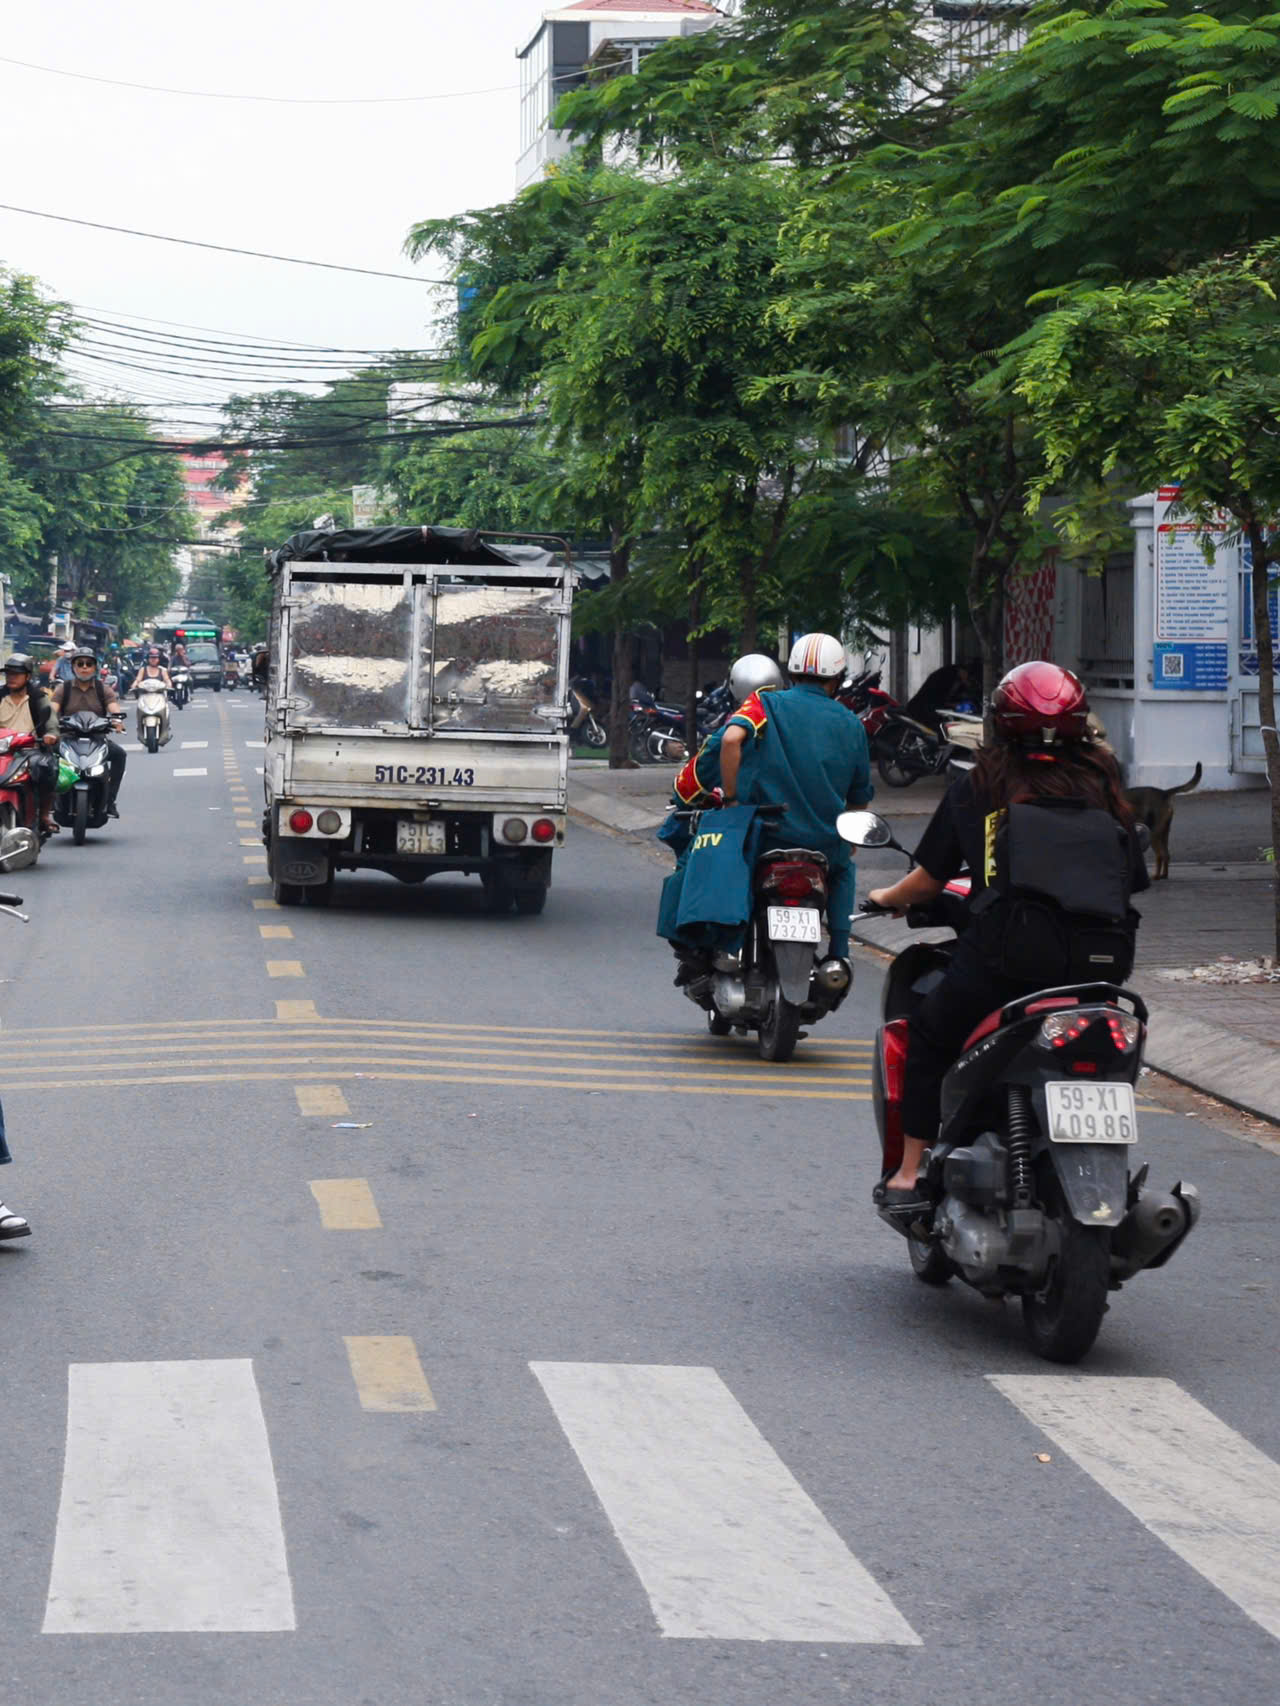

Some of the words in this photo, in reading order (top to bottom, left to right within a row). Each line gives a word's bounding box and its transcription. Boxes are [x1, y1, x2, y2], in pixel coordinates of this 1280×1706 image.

[375, 765, 474, 786] 51C-231.43
[408, 822, 434, 837] 51C
[1060, 1087, 1118, 1111] 59-X1
